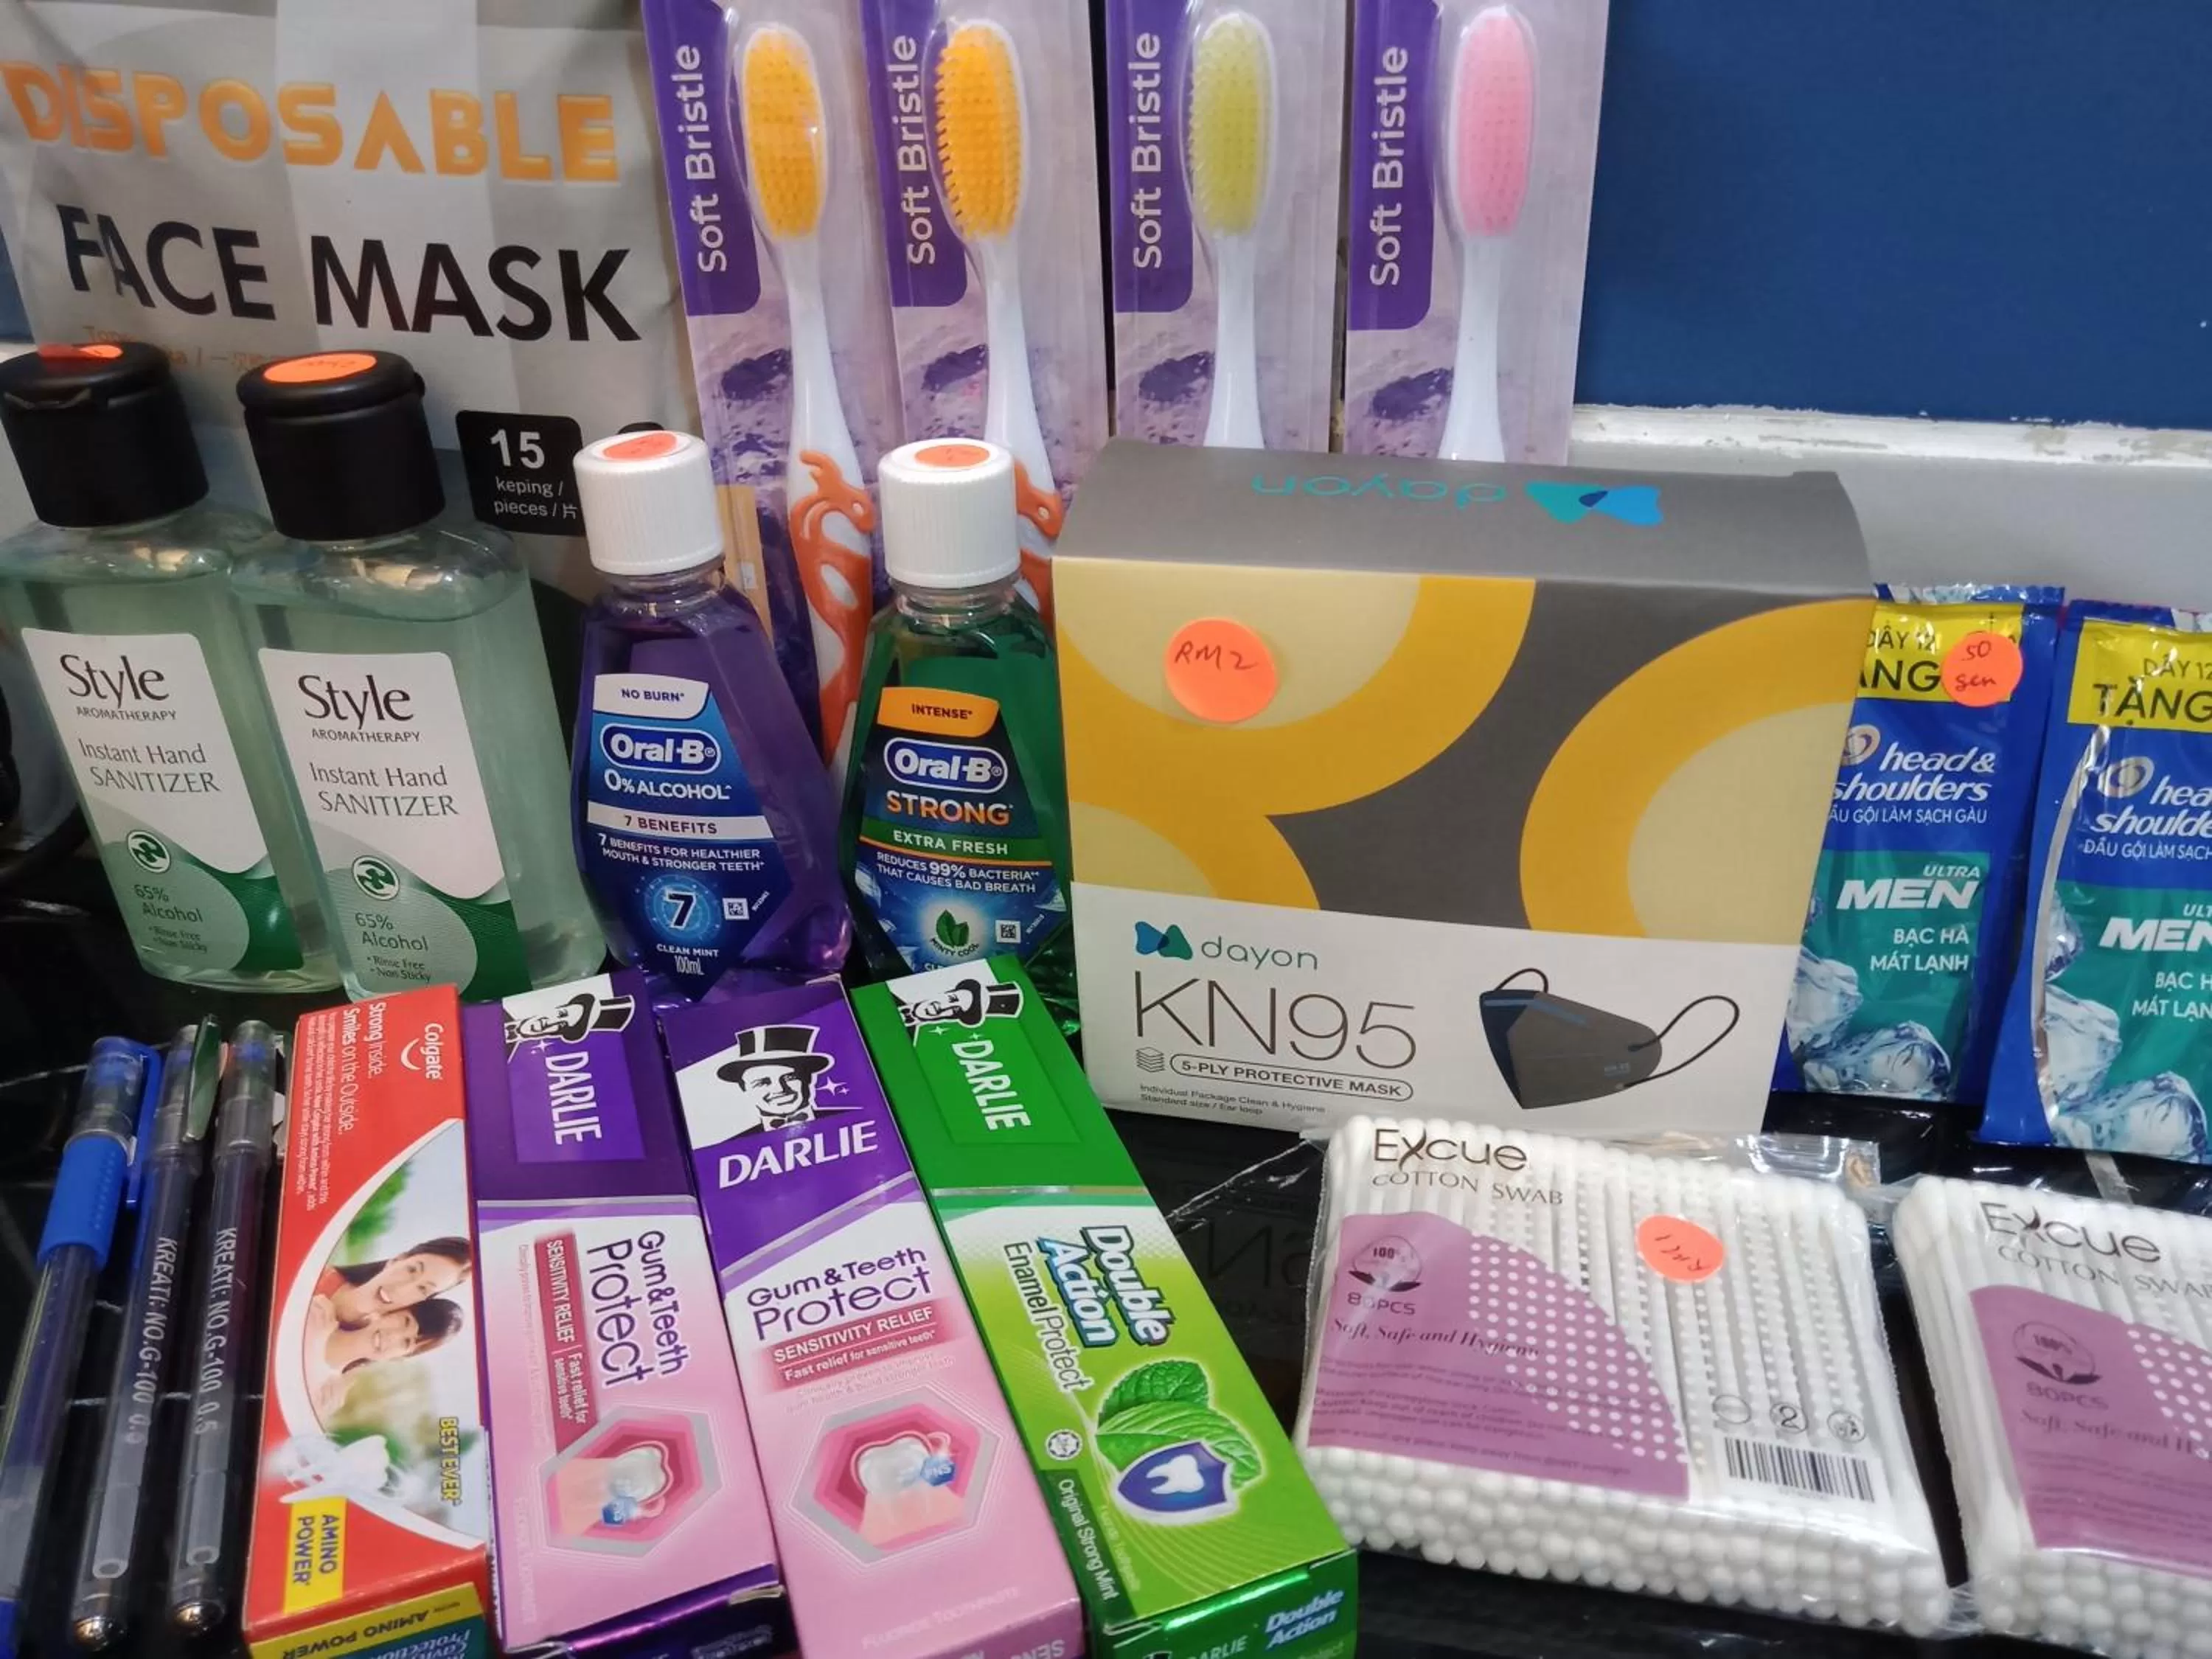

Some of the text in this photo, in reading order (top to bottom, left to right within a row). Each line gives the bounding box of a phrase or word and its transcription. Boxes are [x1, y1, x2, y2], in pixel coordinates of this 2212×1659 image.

[1, 61, 621, 182] DISPOSABLE
[672, 45, 726, 272] Soft Bristle
[886, 35, 936, 265] Soft Bristle
[1127, 32, 1163, 270] Soft Bristle
[1369, 45, 1409, 286] Soft Bristle
[57, 204, 642, 342] FACE MASK
[490, 428, 545, 469] 15
[493, 499, 548, 516] pieces
[495, 476, 553, 498] keping
[1252, 473, 1508, 509] dayon
[60, 653, 170, 709] Style
[621, 689, 640, 699] NO
[76, 706, 177, 722] AROMATHERAPY
[298, 675, 414, 730] Style
[78, 738, 206, 765] Instant Hand
[311, 728, 421, 743] AROMATHERAPY
[90, 766, 220, 793] SANITIZER
[309, 762, 448, 787] Instant Hand
[604, 768, 635, 794] 0%
[1832, 772, 1993, 802] shoulders
[318, 790, 460, 816] SANITIZER
[625, 815, 717, 834] 7 BENEFITS
[893, 830, 1009, 855] EXTRA FRESH
[597, 832, 761, 859] 7 BENEFITS FOR HEALTHIER
[602, 847, 640, 864] MOUTH
[641, 856, 650, 866] &
[652, 858, 717, 872] STRONGER
[877, 852, 928, 872] REDUCES
[929, 861, 967, 880] 99%
[877, 864, 1037, 893] THAT CAUSES BAD BREATH
[1923, 864, 1980, 877] ULTRA
[142, 902, 203, 922] Alcohol
[664, 888, 697, 931] 7
[1836, 879, 1981, 909] MEN
[355, 912, 393, 930] 65%
[362, 931, 428, 951] Alcohol
[1200, 935, 1318, 970] dayon
[342, 1008, 361, 1046] Smiles
[364, 1003, 386, 1042] Strong
[1135, 970, 1416, 1070] KN95
[420, 1023, 443, 1079] Colgate
[546, 1051, 602, 1144] DARLIE
[951, 1040, 1032, 1131] DARLIE
[1181, 1060, 1402, 1098] 5-PLY PROTECTIVE MASK
[719, 1121, 879, 1189] DARLIE
[1374, 1127, 1528, 1172] Excue
[1372, 1171, 1564, 1206] COTTON SWAB
[1980, 1202, 2161, 1262] Excue
[1080, 1225, 1175, 1346] Double
[1998, 1246, 2120, 1285] COTTON
[546, 1239, 575, 1343] SENSITIVITY RELIEF
[752, 1265, 932, 1343] Protect
[1036, 1237, 1119, 1348] Action
[587, 1239, 654, 1385] Protect
[1004, 1241, 1096, 1392] Enamel Protect
[773, 1306, 933, 1364] SENSITIVITY RELIEF
[568, 1352, 582, 1376] Fast
[785, 1366, 815, 1382] Fast
[816, 1353, 848, 1373] relief
[849, 1349, 866, 1362] for
[866, 1338, 908, 1357] sensitive
[439, 1416, 459, 1457] BEST
[293, 1515, 315, 1585] POWER
[319, 1514, 339, 1574] AMINO
[1058, 1478, 1120, 1600] Original Strong Mint
[1265, 1590, 1344, 1632] Double
[1266, 1609, 1337, 1650] Action
[282, 1610, 429, 1659] AMINO POWER
